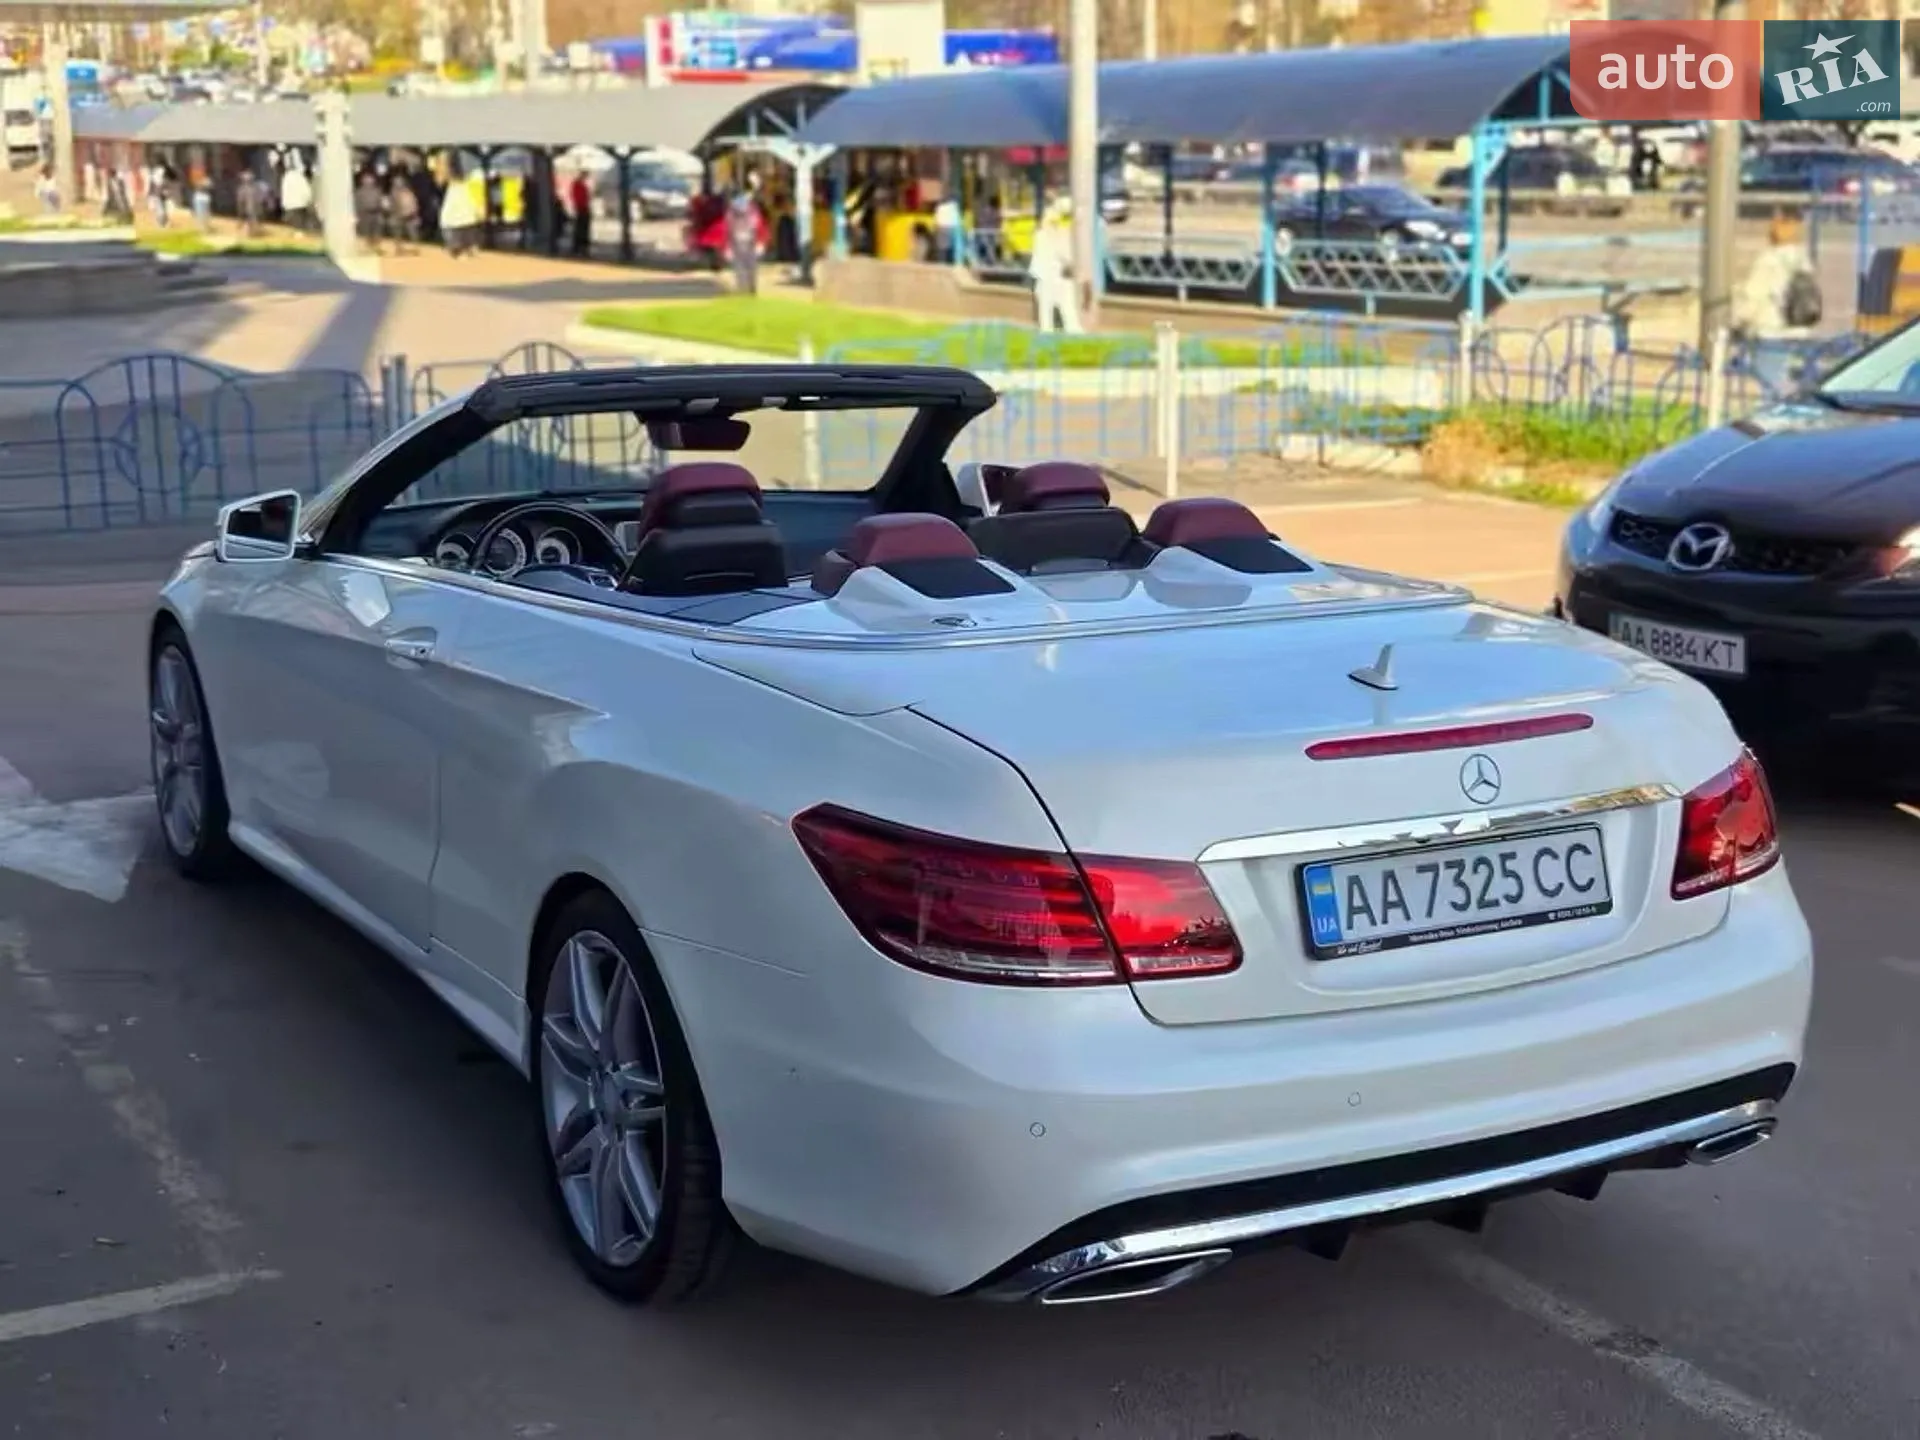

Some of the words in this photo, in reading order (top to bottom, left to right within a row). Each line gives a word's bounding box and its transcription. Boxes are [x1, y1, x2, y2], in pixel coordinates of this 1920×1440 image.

[1622, 621, 1646, 648] AA
[1650, 628, 1698, 662] 8884
[1704, 640, 1738, 668] KT
[1346, 869, 1412, 931] AA
[1415, 851, 1524, 918] 7325
[1533, 842, 1595, 898] CC
[1316, 917, 1339, 933] UA
